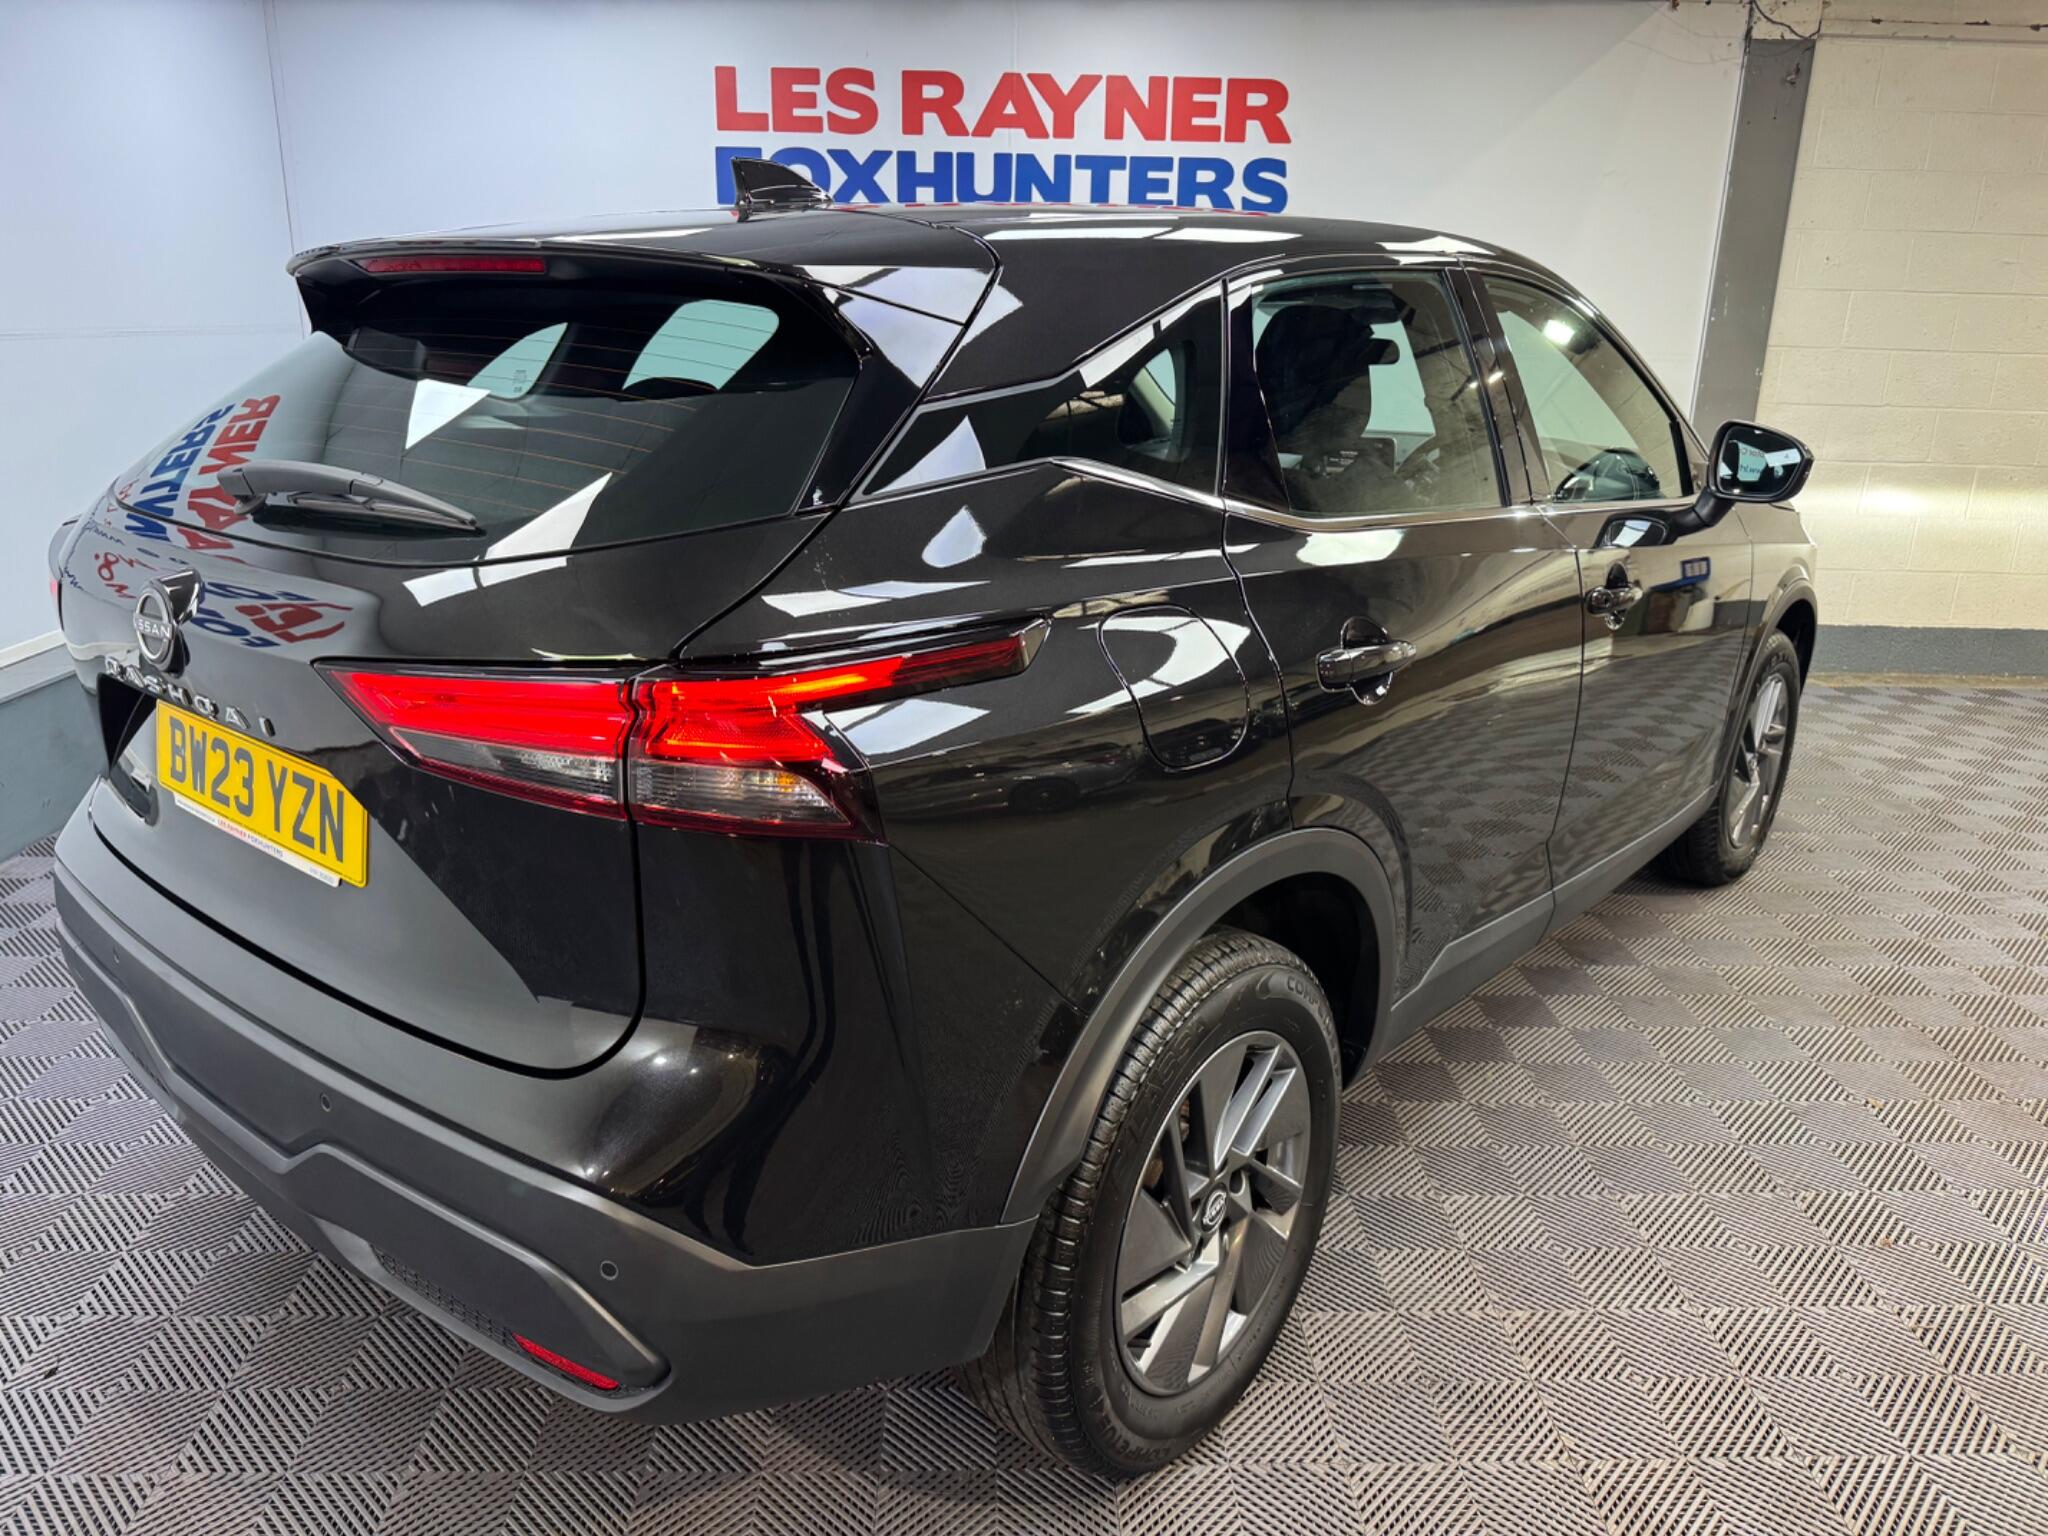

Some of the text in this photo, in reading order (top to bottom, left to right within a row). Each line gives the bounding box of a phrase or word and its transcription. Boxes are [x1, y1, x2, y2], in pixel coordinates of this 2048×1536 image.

[715, 66, 1291, 143] LES RAYNER
[715, 146, 1288, 213] FOXHUNTERS
[134, 622, 174, 646] SSAN
[105, 656, 276, 738] QASHQAI
[169, 715, 344, 863] BW23 YZN
